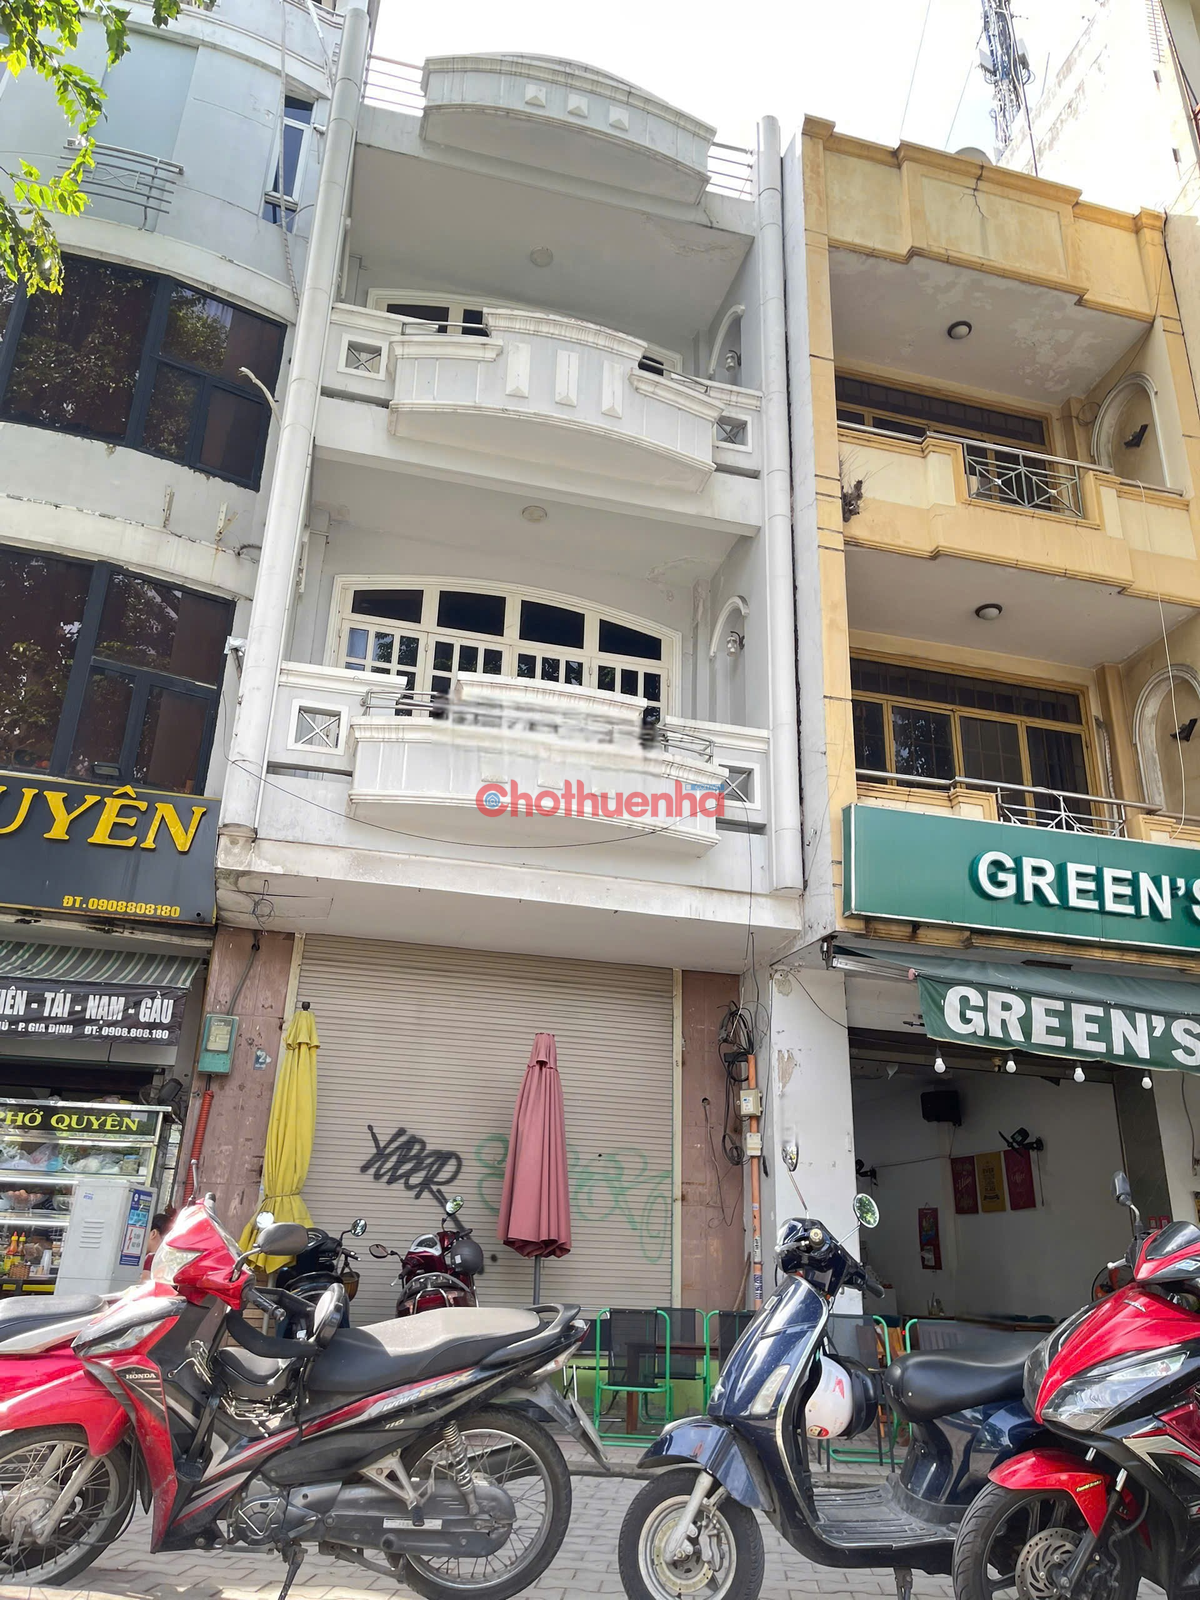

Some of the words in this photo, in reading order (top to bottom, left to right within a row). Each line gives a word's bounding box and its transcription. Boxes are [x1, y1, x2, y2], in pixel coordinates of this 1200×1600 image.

[62, 895, 181, 918] ĐT.0908808180
[43, 989, 72, 1018] TÁI
[85, 994, 126, 1025] NẠM
[138, 991, 174, 1024] GẦU
[28, 1022, 46, 1033] GIA
[48, 1024, 74, 1035] ĐỊNH
[101, 1026, 169, 1040] 0908.808.180
[50, 1113, 140, 1131] QUYÊN
[125, 1372, 156, 1380] HONDA
[384, 1418, 405, 1430] 110
